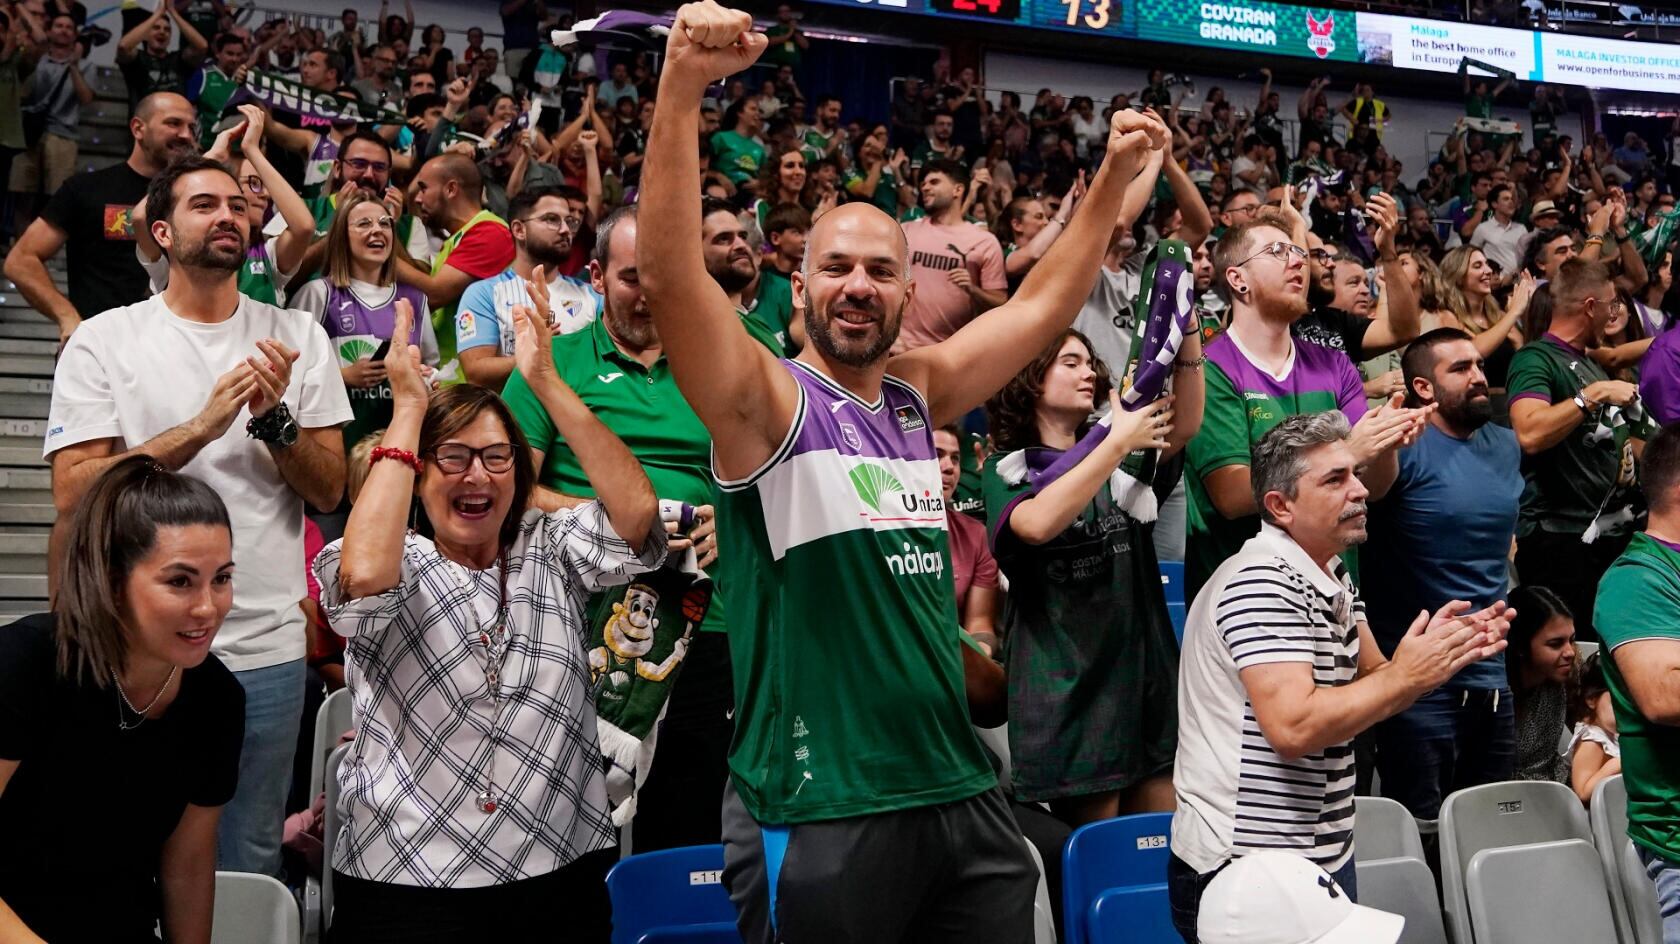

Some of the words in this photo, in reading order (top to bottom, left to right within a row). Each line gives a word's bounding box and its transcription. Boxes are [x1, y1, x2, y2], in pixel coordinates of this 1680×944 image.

[1201, 3, 1276, 26] COVIRAN
[1201, 22, 1277, 46] GRANADA
[1412, 39, 1429, 49] the
[1432, 41, 1454, 52] best
[1457, 43, 1487, 54] home
[1488, 47, 1516, 57] office
[1412, 52, 1422, 61] in
[1599, 53, 1646, 64] INVESTOR
